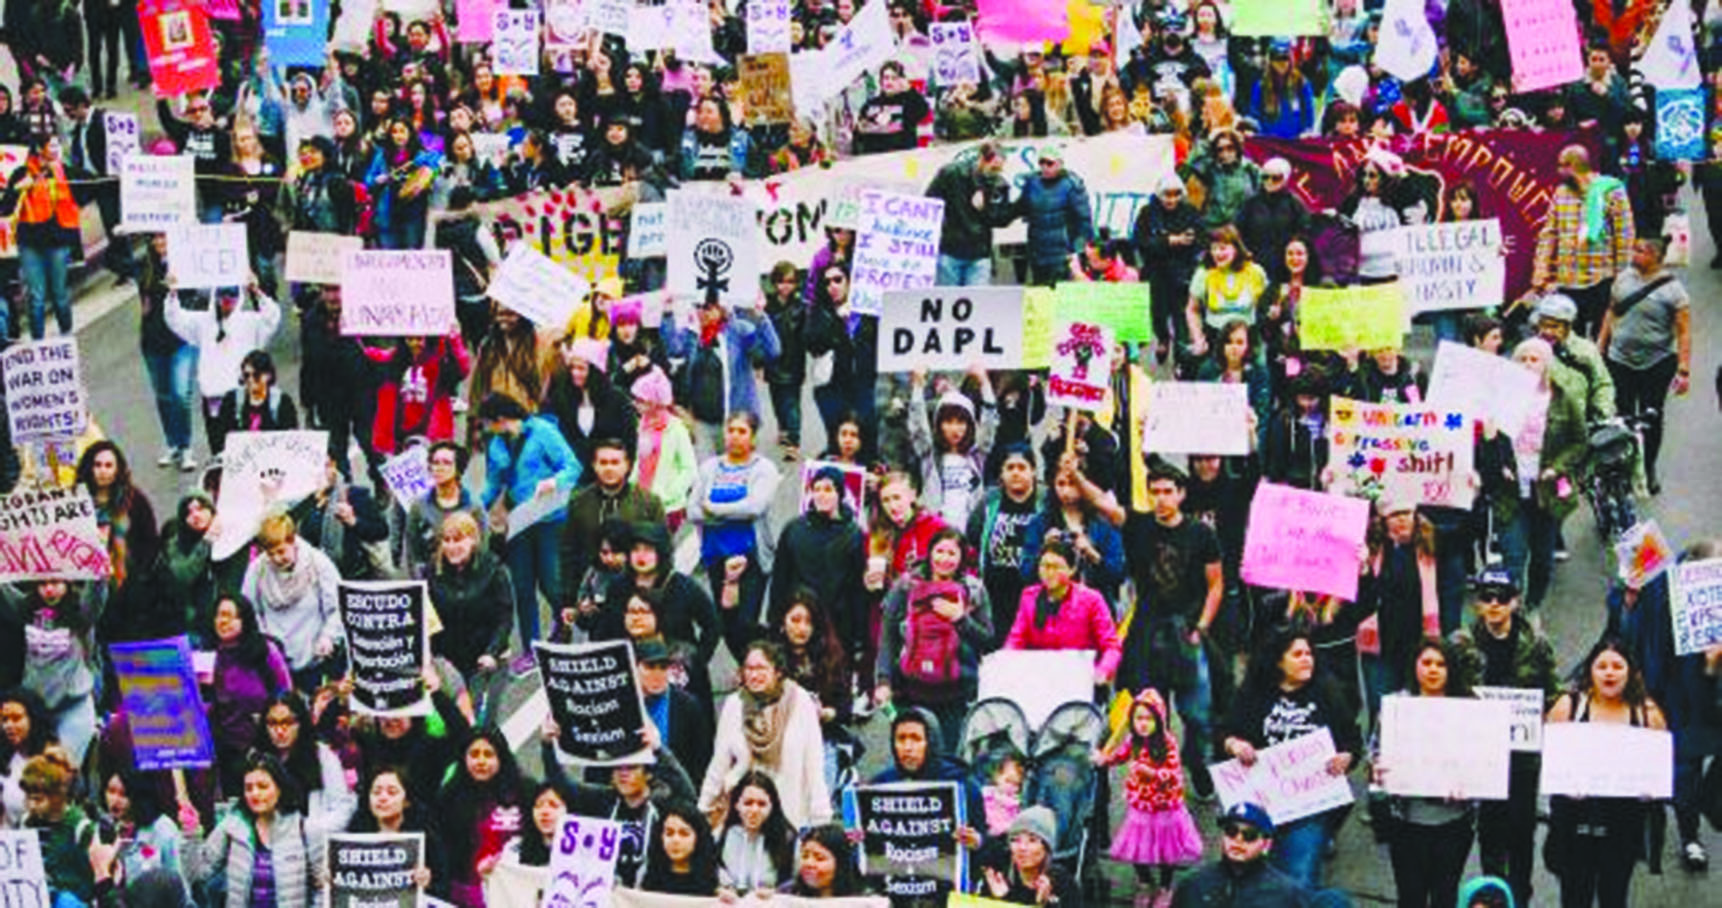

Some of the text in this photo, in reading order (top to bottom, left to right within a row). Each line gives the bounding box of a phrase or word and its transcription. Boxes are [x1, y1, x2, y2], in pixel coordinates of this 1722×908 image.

[921, 297, 973, 323] NO
[893, 328, 1004, 355] DAPL
[39, 343, 74, 362] THE
[8, 367, 73, 391] WAR ON
[54, 499, 92, 523] ARE
[549, 655, 617, 673] SHIELD
[547, 672, 629, 695] AGAINST
[871, 796, 942, 814] SHIELD
[866, 818, 952, 836] AGAINST
[338, 847, 407, 866] SHIELD
